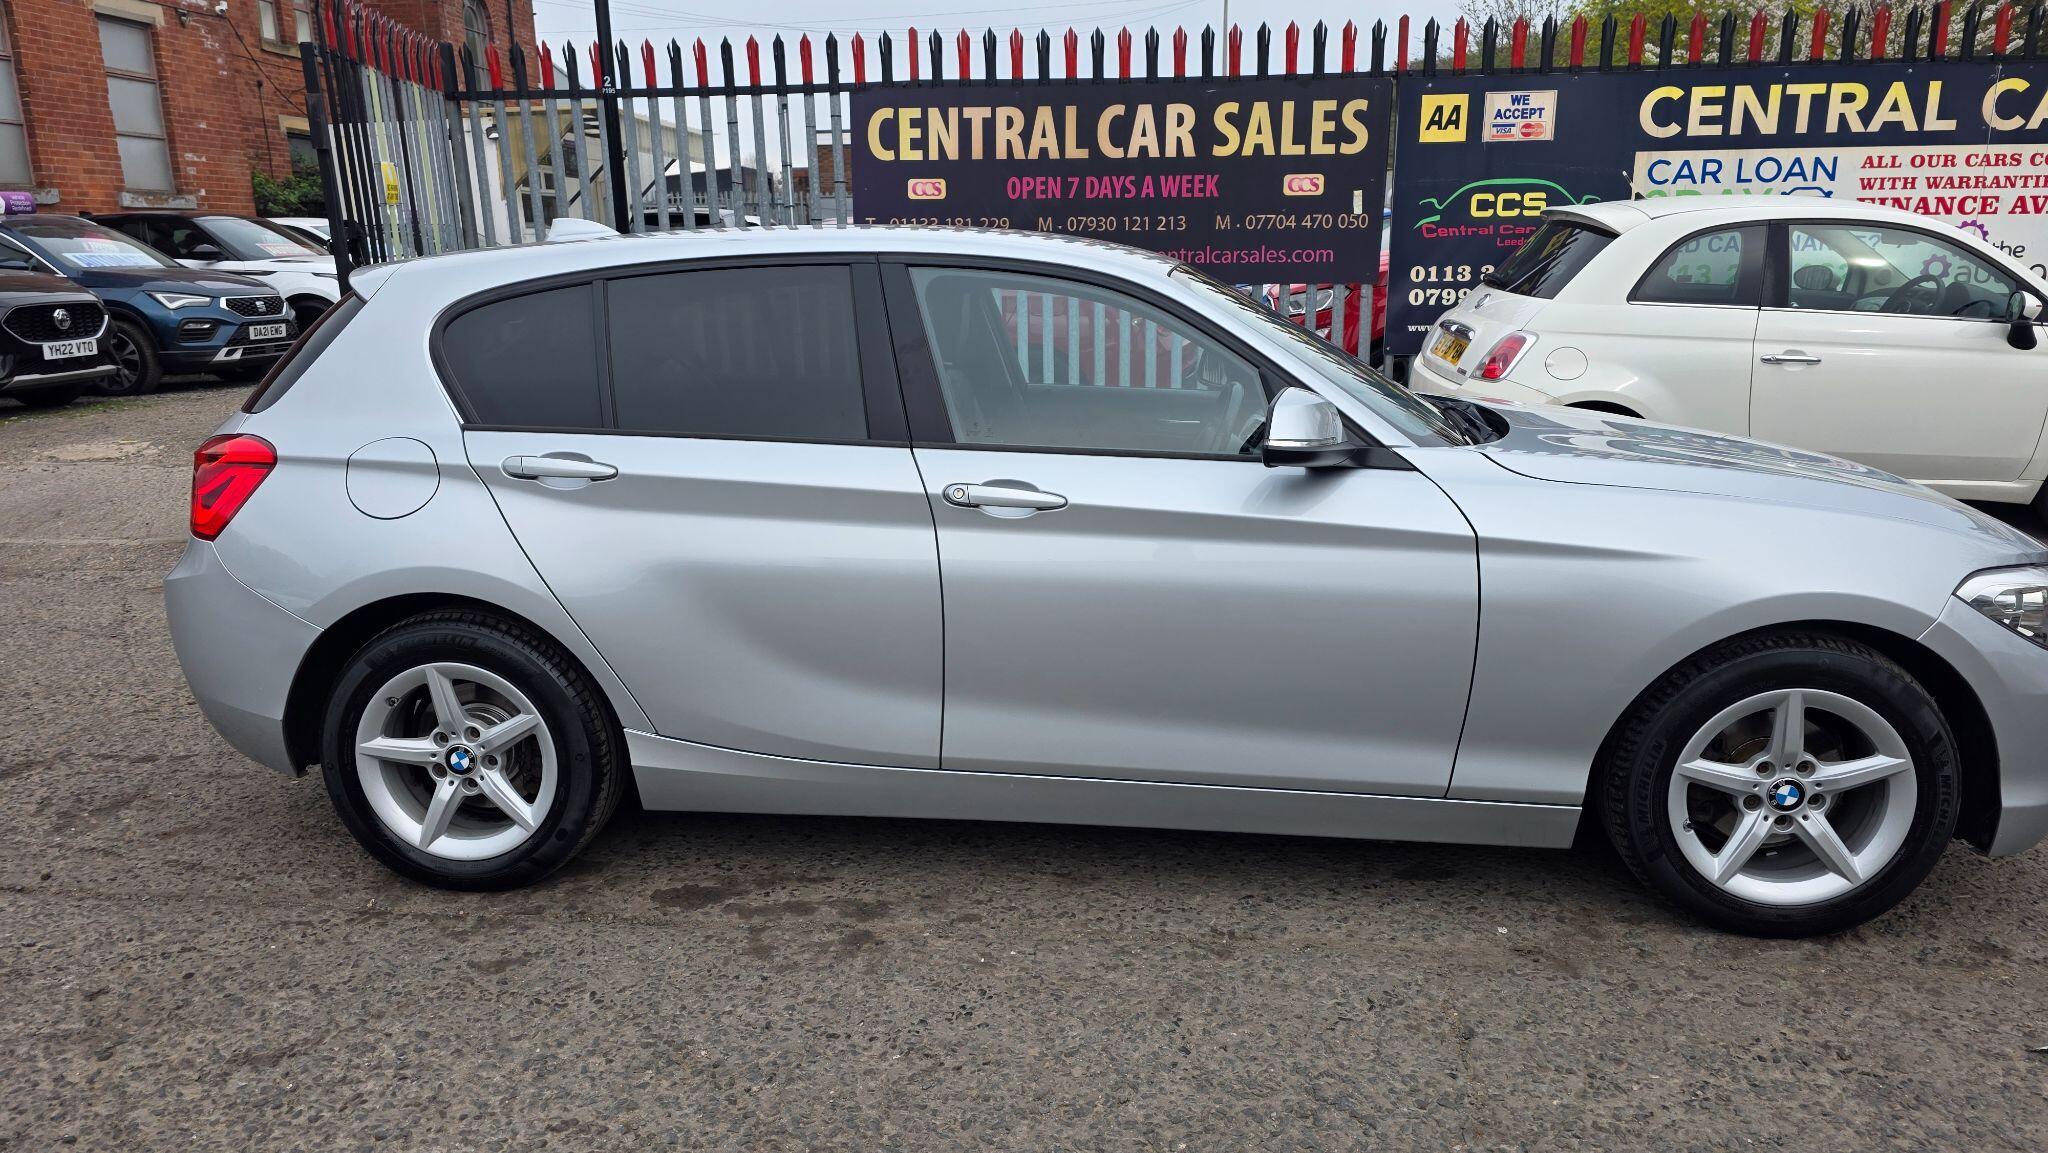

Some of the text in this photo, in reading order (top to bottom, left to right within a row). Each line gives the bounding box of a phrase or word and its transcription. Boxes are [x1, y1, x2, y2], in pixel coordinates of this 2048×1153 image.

[603, 76, 612, 86] 2
[1510, 94, 1531, 106] WE
[1424, 104, 1461, 131] AA
[1493, 107, 1545, 120] ACCEPT
[1638, 81, 1958, 138] CENTRAL
[866, 98, 1369, 162] CENTRAL CAR SALES
[1860, 155, 1902, 169] ALL
[1910, 154, 1958, 168] OUR
[1964, 152, 2022, 167] CARS
[1647, 156, 1839, 185] CAR LOAN
[910, 173, 1321, 201] CCS OPEN 7 DAYS A WEEK CCS
[1858, 176, 1918, 190] WITH
[1470, 191, 1547, 218] CCS
[1037, 215, 1187, 232] M 07930 121 213
[1214, 213, 1369, 230] M 07704 470 050
[1421, 223, 1537, 238] Central Car
[1409, 264, 1473, 283] 0113
[47, 340, 95, 357] YH22 VTO
